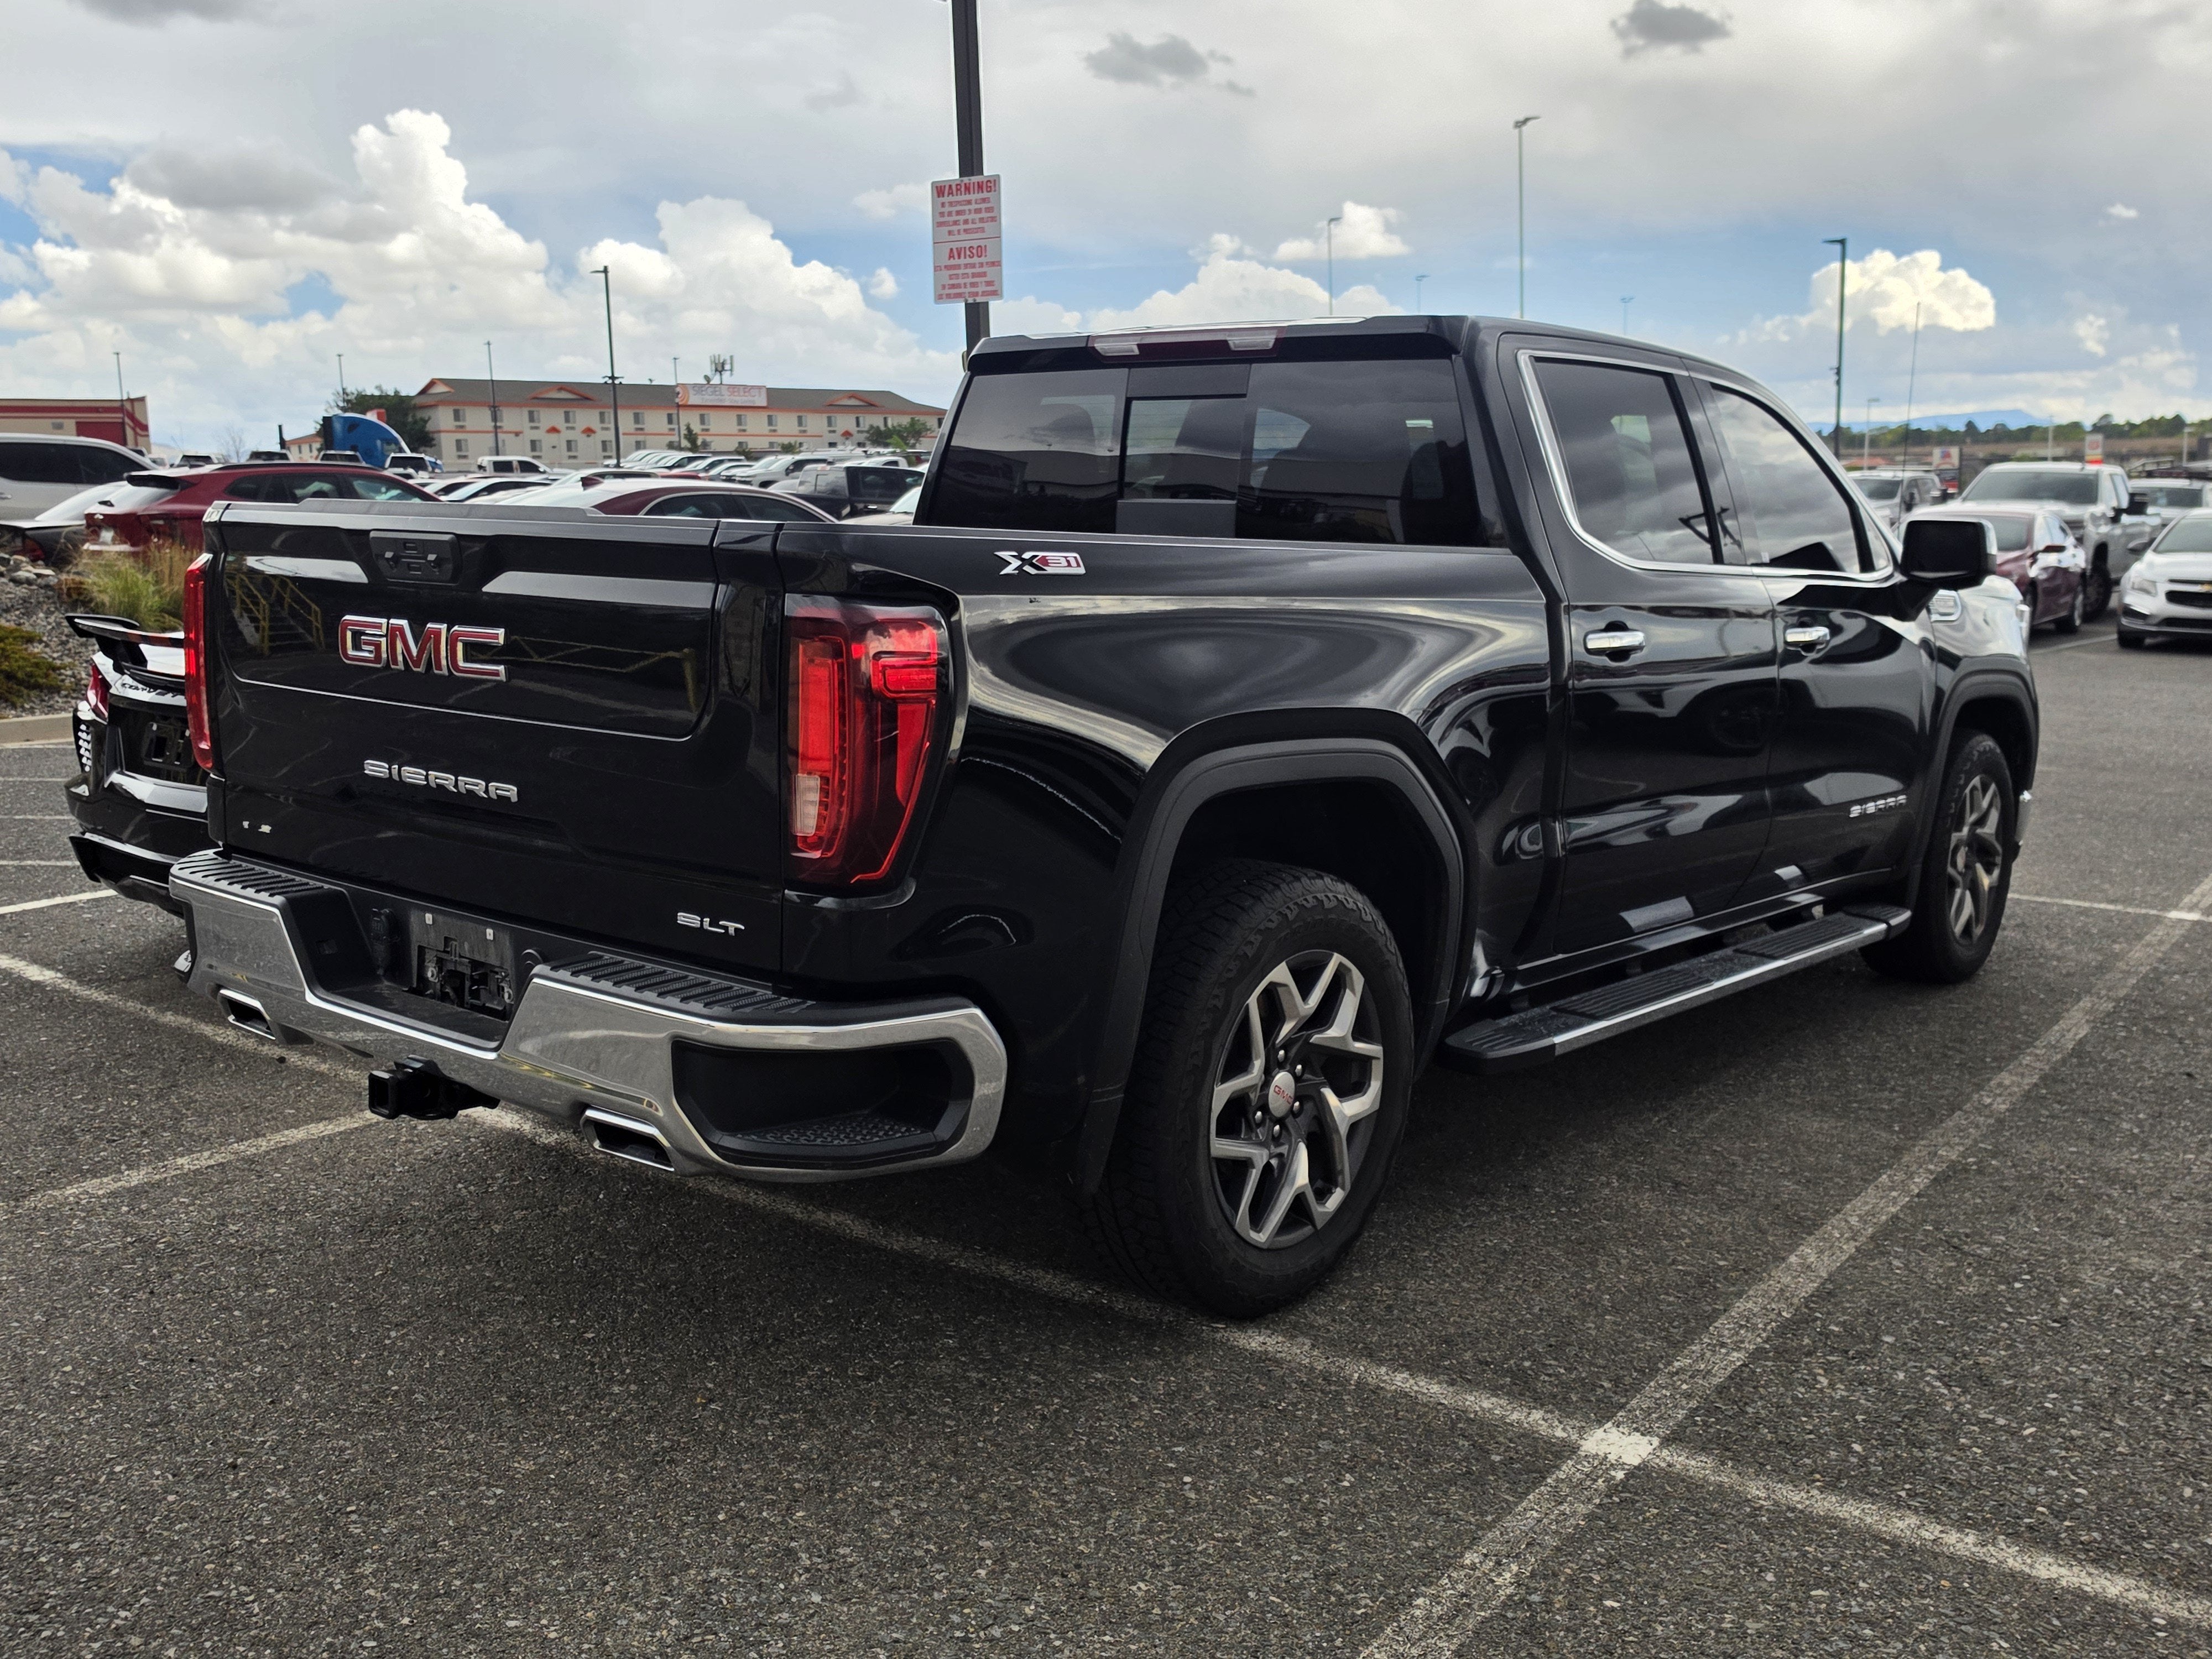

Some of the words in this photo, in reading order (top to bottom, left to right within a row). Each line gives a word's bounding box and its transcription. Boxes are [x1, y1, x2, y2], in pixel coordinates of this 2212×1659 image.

[936, 179, 997, 198] WARNING!
[948, 244, 987, 260] AVISO!
[727, 387, 762, 398] SELECT
[994, 551, 1086, 575] X31
[338, 614, 507, 682] GMC
[121, 682, 186, 700] CORVET
[363, 759, 518, 802] SIERRA
[1849, 795, 1907, 818] SIERRA
[677, 912, 745, 936] SLT
[1274, 1084, 1293, 1104] GMC
